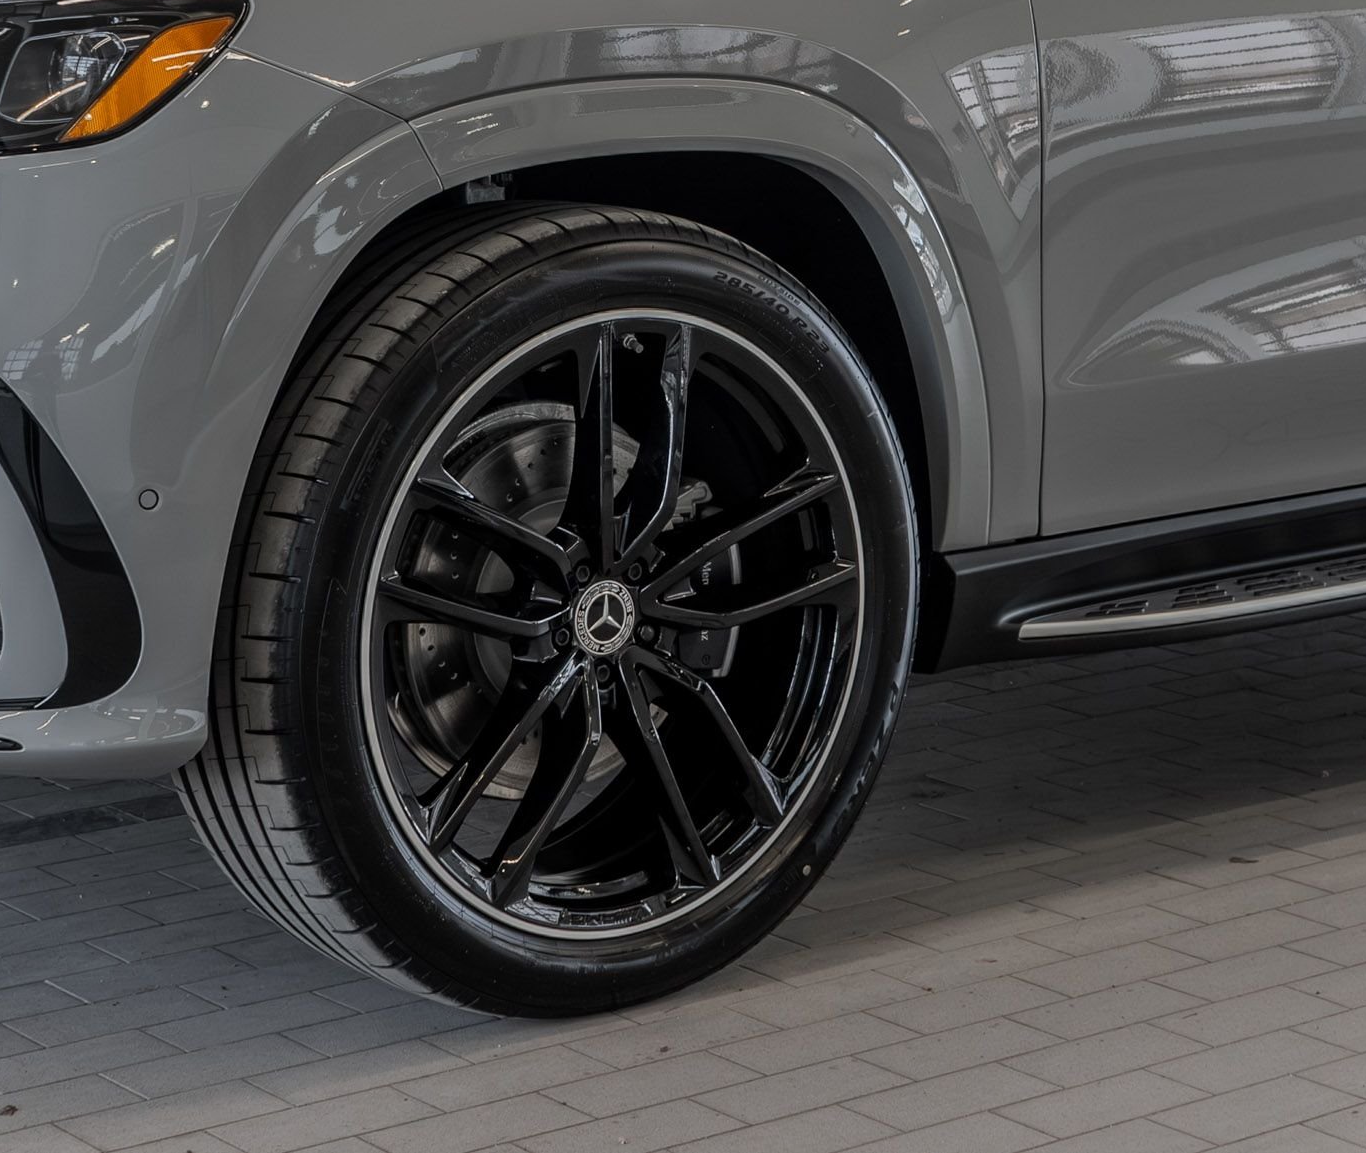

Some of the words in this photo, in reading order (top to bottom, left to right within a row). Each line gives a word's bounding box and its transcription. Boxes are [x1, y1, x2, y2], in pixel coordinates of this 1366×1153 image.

[712, 270, 791, 316] 285/40
[619, 589, 634, 614] BENZ
[577, 609, 601, 652] MERCEDES
